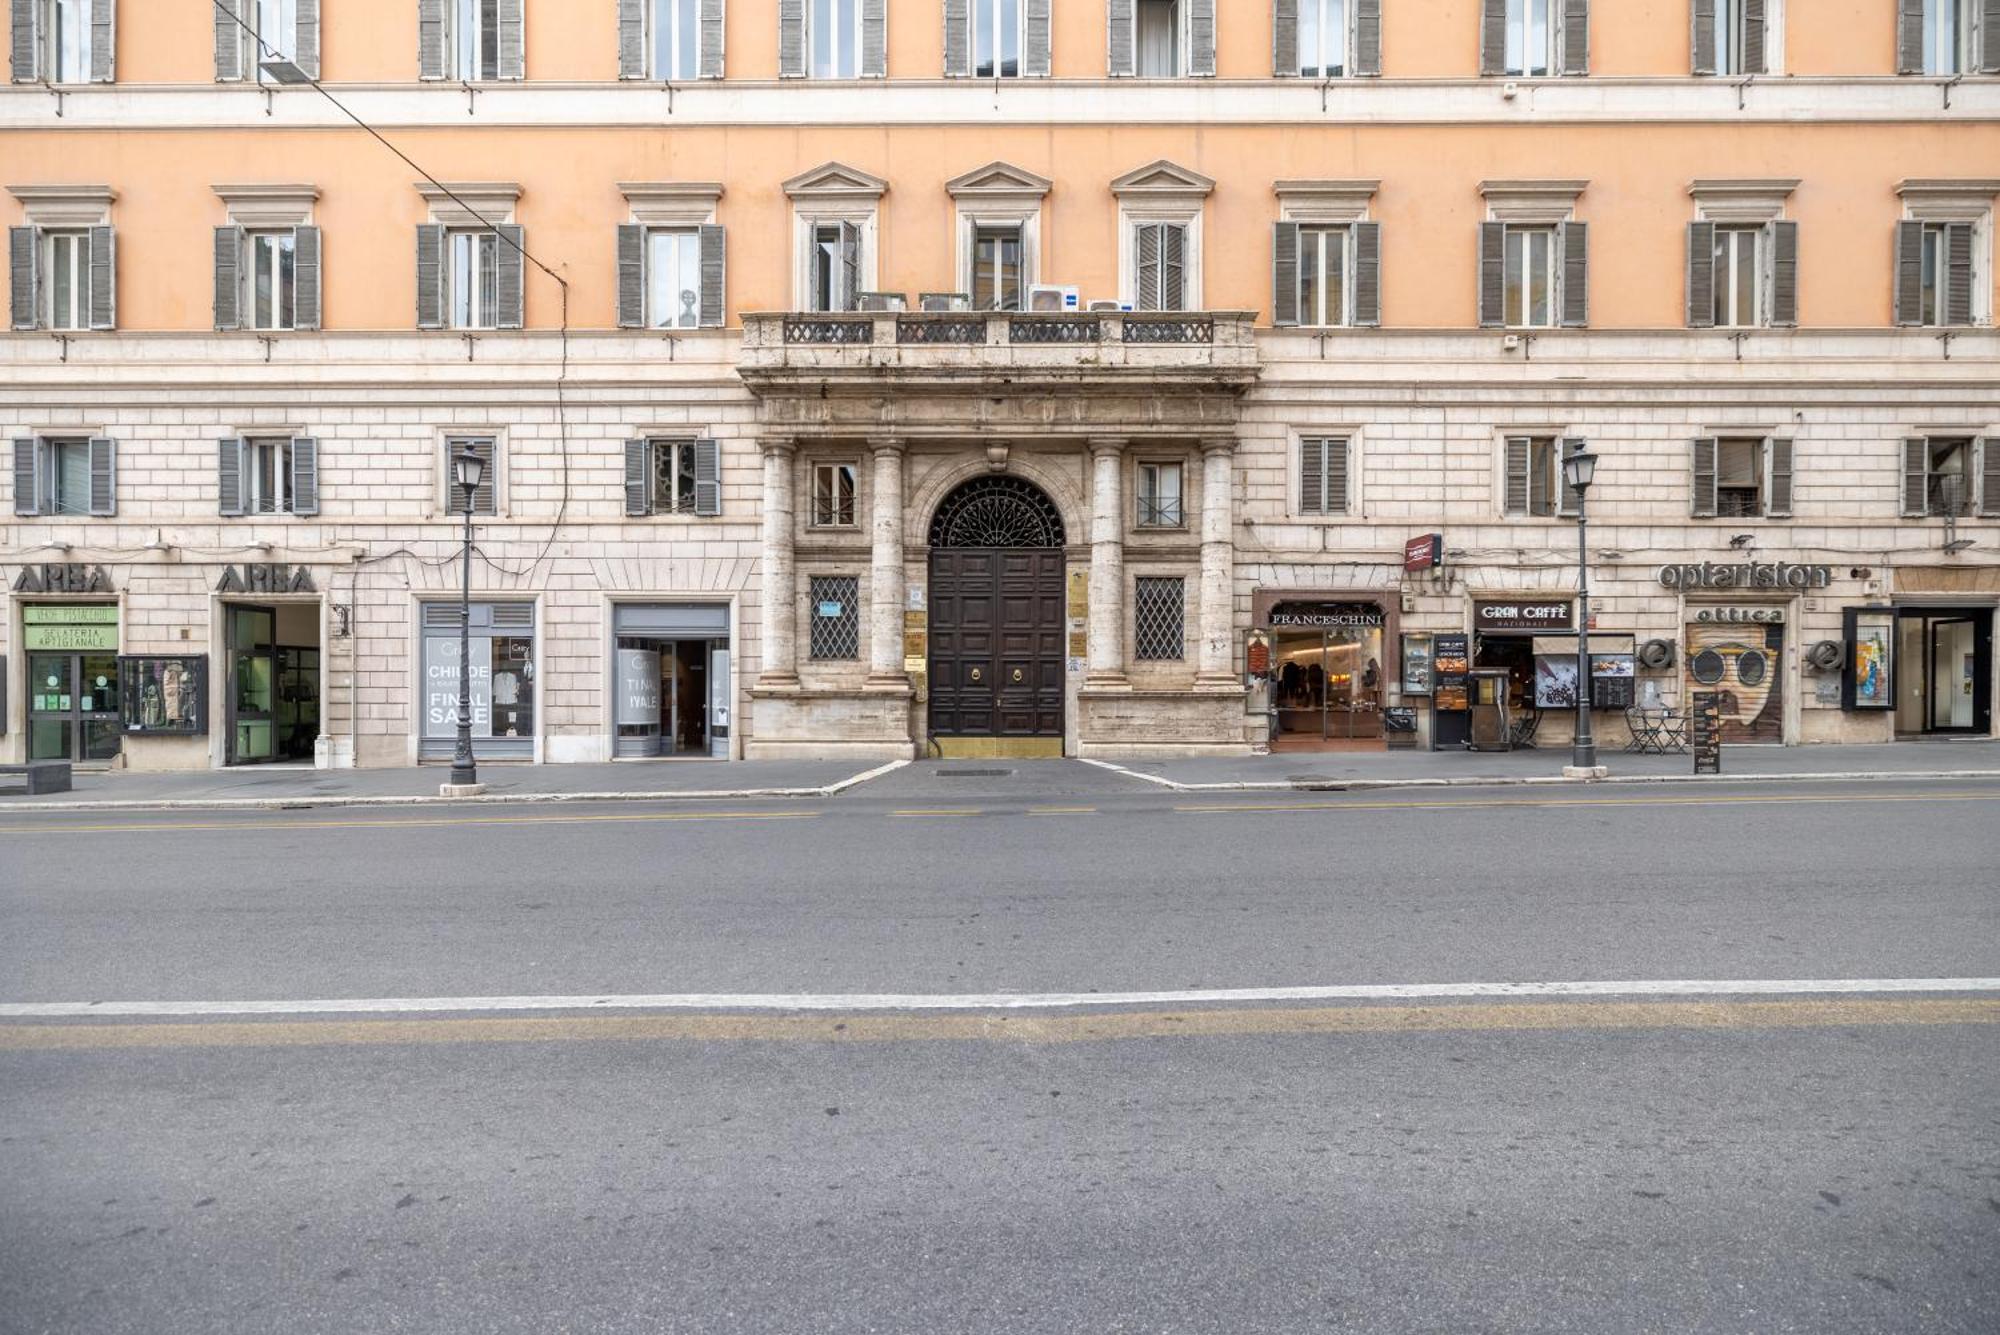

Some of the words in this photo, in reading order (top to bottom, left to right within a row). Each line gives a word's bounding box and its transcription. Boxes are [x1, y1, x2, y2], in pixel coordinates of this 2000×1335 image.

[13, 563, 114, 592] AREA
[215, 563, 318, 592] AREA
[1657, 561, 1832, 592] optariston
[1273, 615, 1382, 625] FRANCESCHINI
[1481, 606, 1519, 619] GRAN
[1696, 608, 1783, 623] ottica
[429, 707, 488, 725] SAE
